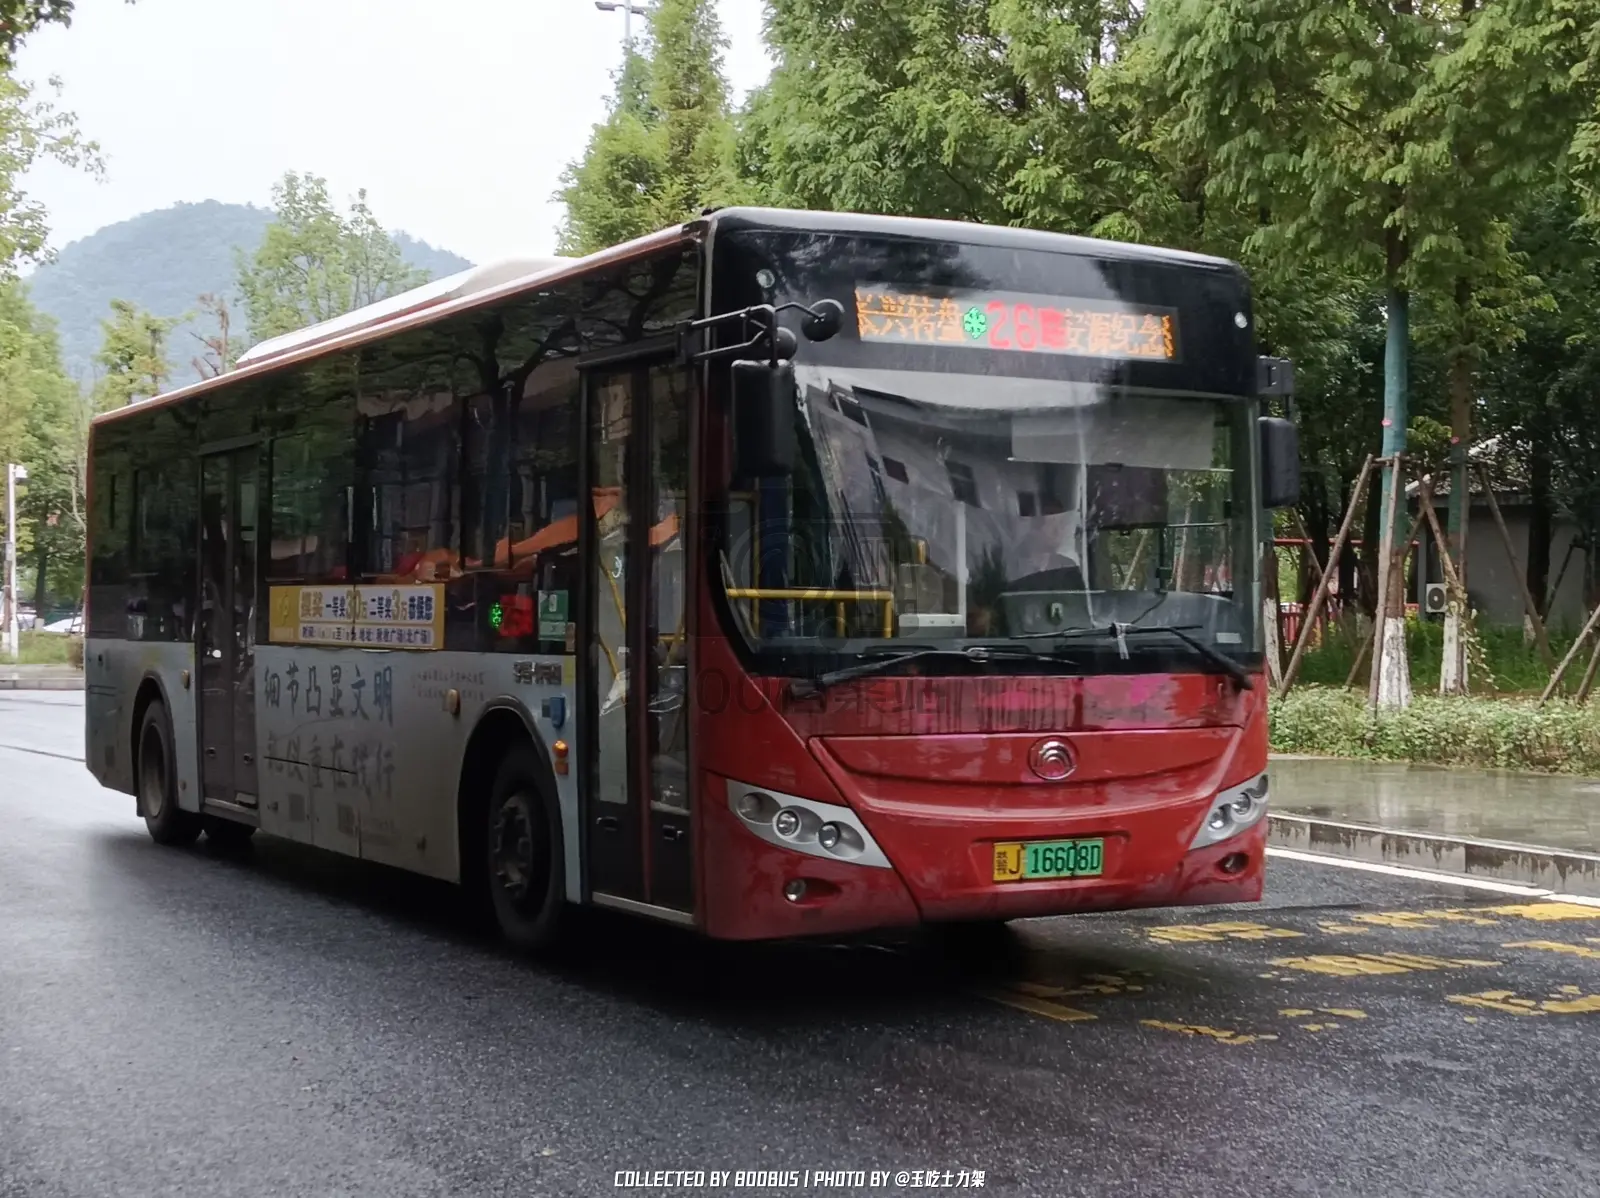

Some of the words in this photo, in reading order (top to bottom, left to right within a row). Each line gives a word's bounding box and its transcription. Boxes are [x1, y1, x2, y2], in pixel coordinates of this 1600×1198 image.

[264, 661, 393, 728] 细节凸显文明
[1031, 844, 1101, 874] 16608D
